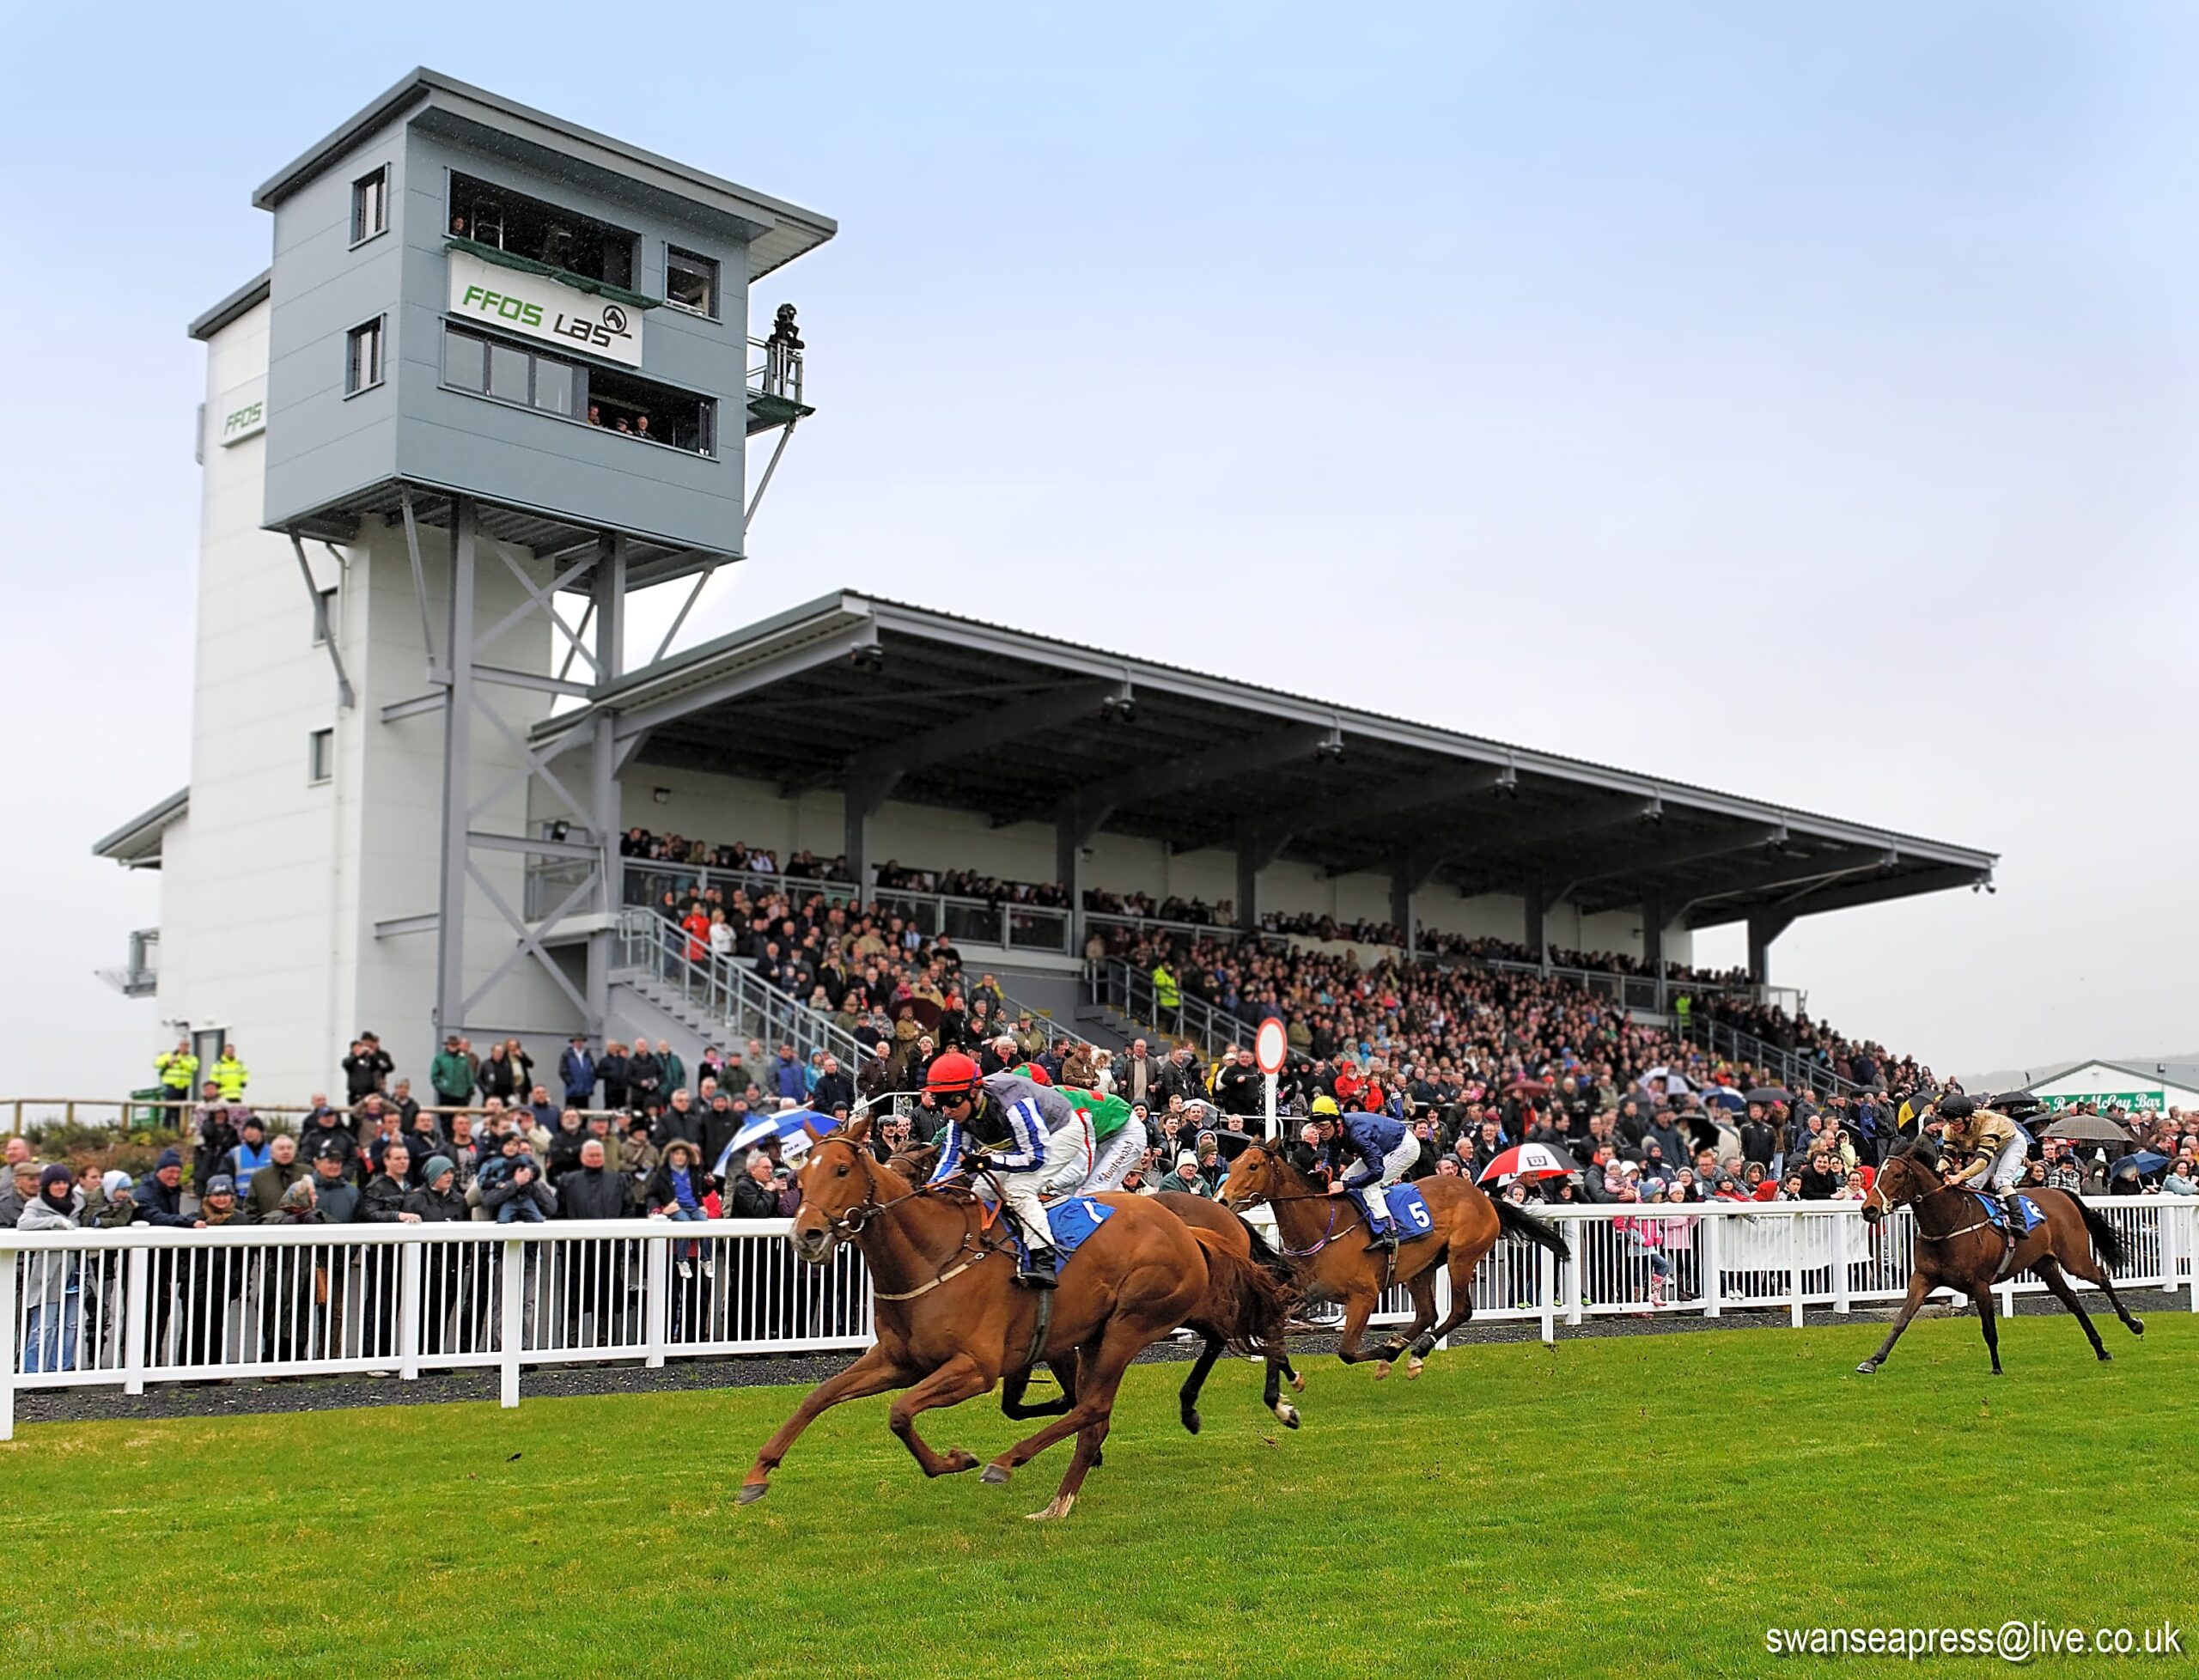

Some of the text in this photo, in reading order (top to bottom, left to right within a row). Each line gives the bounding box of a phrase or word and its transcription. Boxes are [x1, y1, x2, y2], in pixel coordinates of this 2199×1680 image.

[462, 285, 544, 327] FFOS
[224, 401, 262, 436] FFOS
[2135, 1093, 2162, 1108] Bar
[1408, 1201, 1430, 1228] 5
